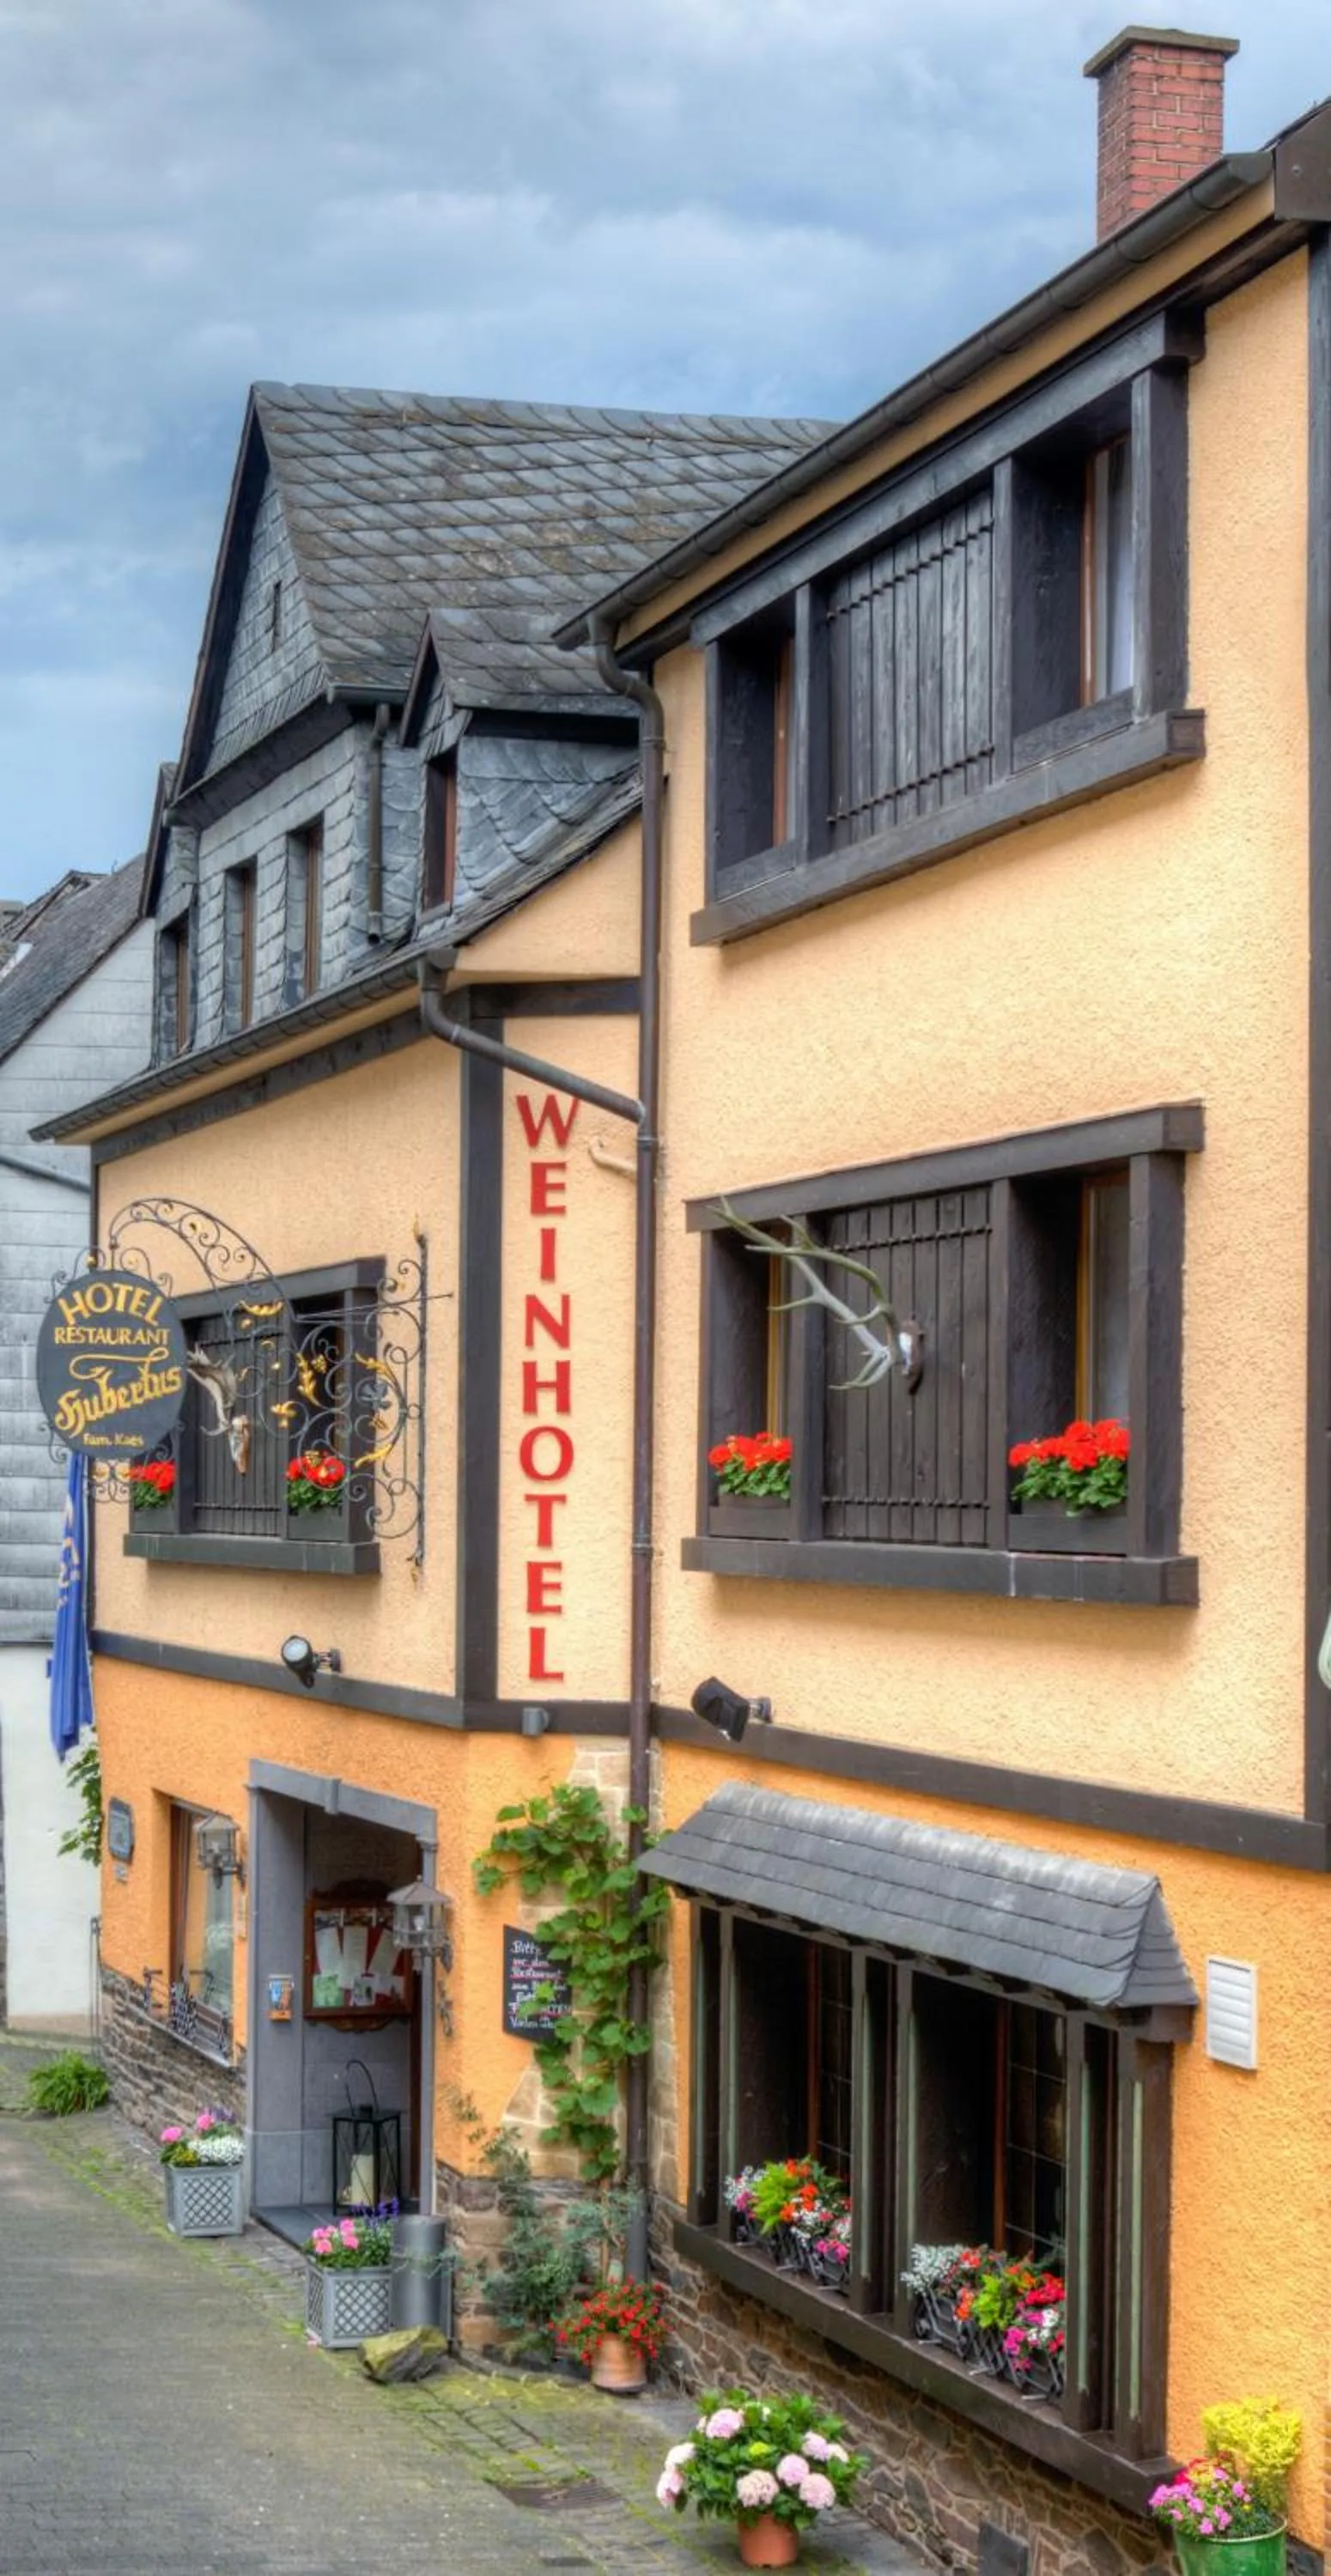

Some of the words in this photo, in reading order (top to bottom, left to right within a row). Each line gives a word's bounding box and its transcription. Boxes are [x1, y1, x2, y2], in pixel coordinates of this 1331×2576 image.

[54, 1327, 169, 1345] RESTAURANT
[58, 1282, 163, 1326] HOTEL
[54, 1347, 182, 1438] Hubertus
[517, 1094, 581, 1681] WEINHOTEL
